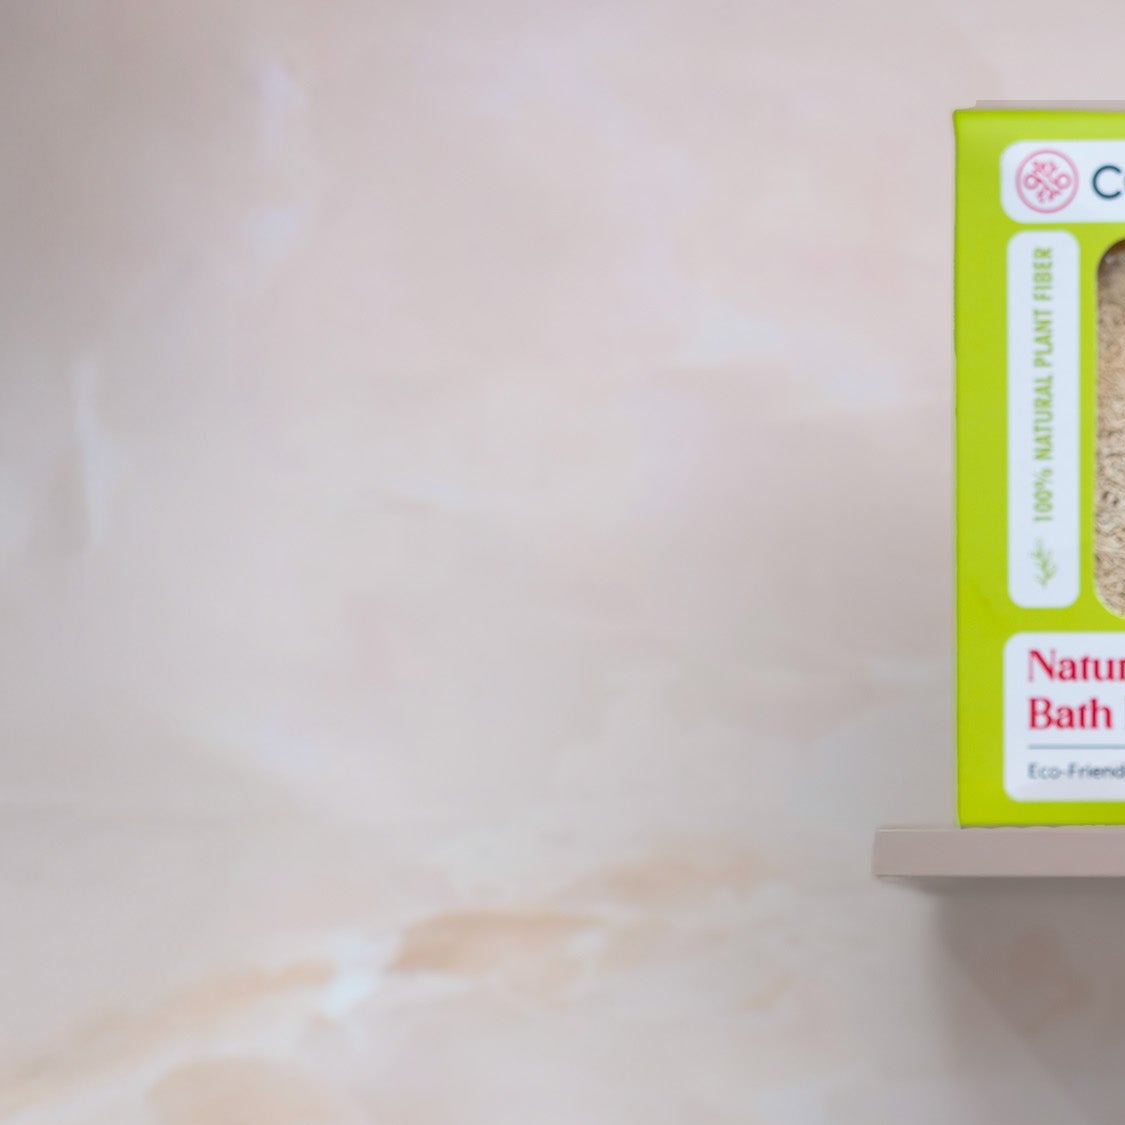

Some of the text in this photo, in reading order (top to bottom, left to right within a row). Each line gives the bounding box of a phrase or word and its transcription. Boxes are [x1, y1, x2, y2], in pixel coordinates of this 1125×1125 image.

[1034, 247, 1054, 523] 100% NATURAL PLANT FIBER
[1028, 697, 1113, 730] Bath
